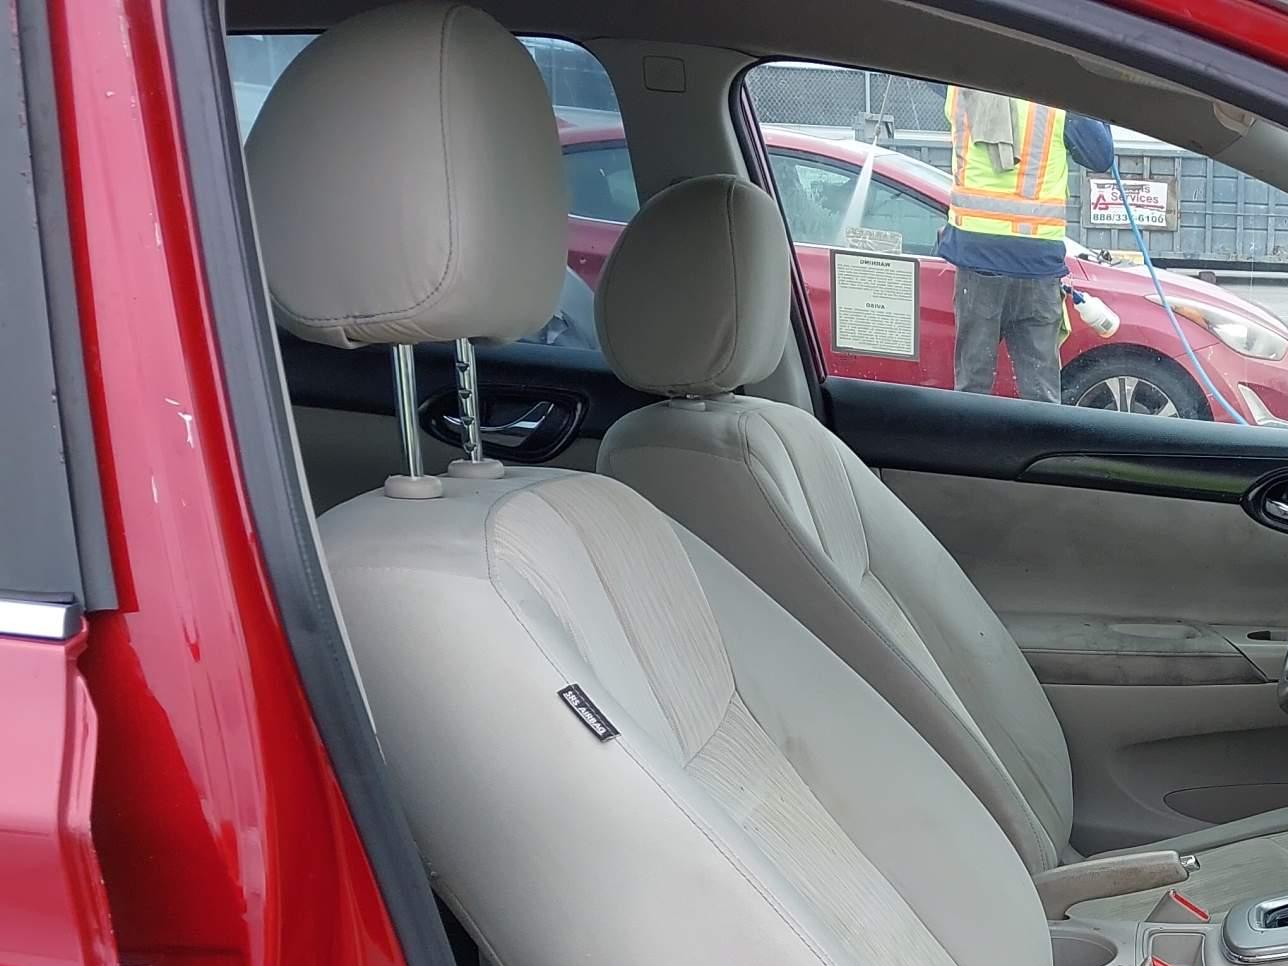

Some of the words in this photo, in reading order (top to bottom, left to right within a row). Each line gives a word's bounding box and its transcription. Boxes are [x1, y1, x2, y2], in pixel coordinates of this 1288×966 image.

[1110, 191, 1159, 204] Services
[1093, 213, 1164, 223] 888/33-6100
[565, 690, 580, 706] SRS
[578, 707, 606, 734] AIRBAG
